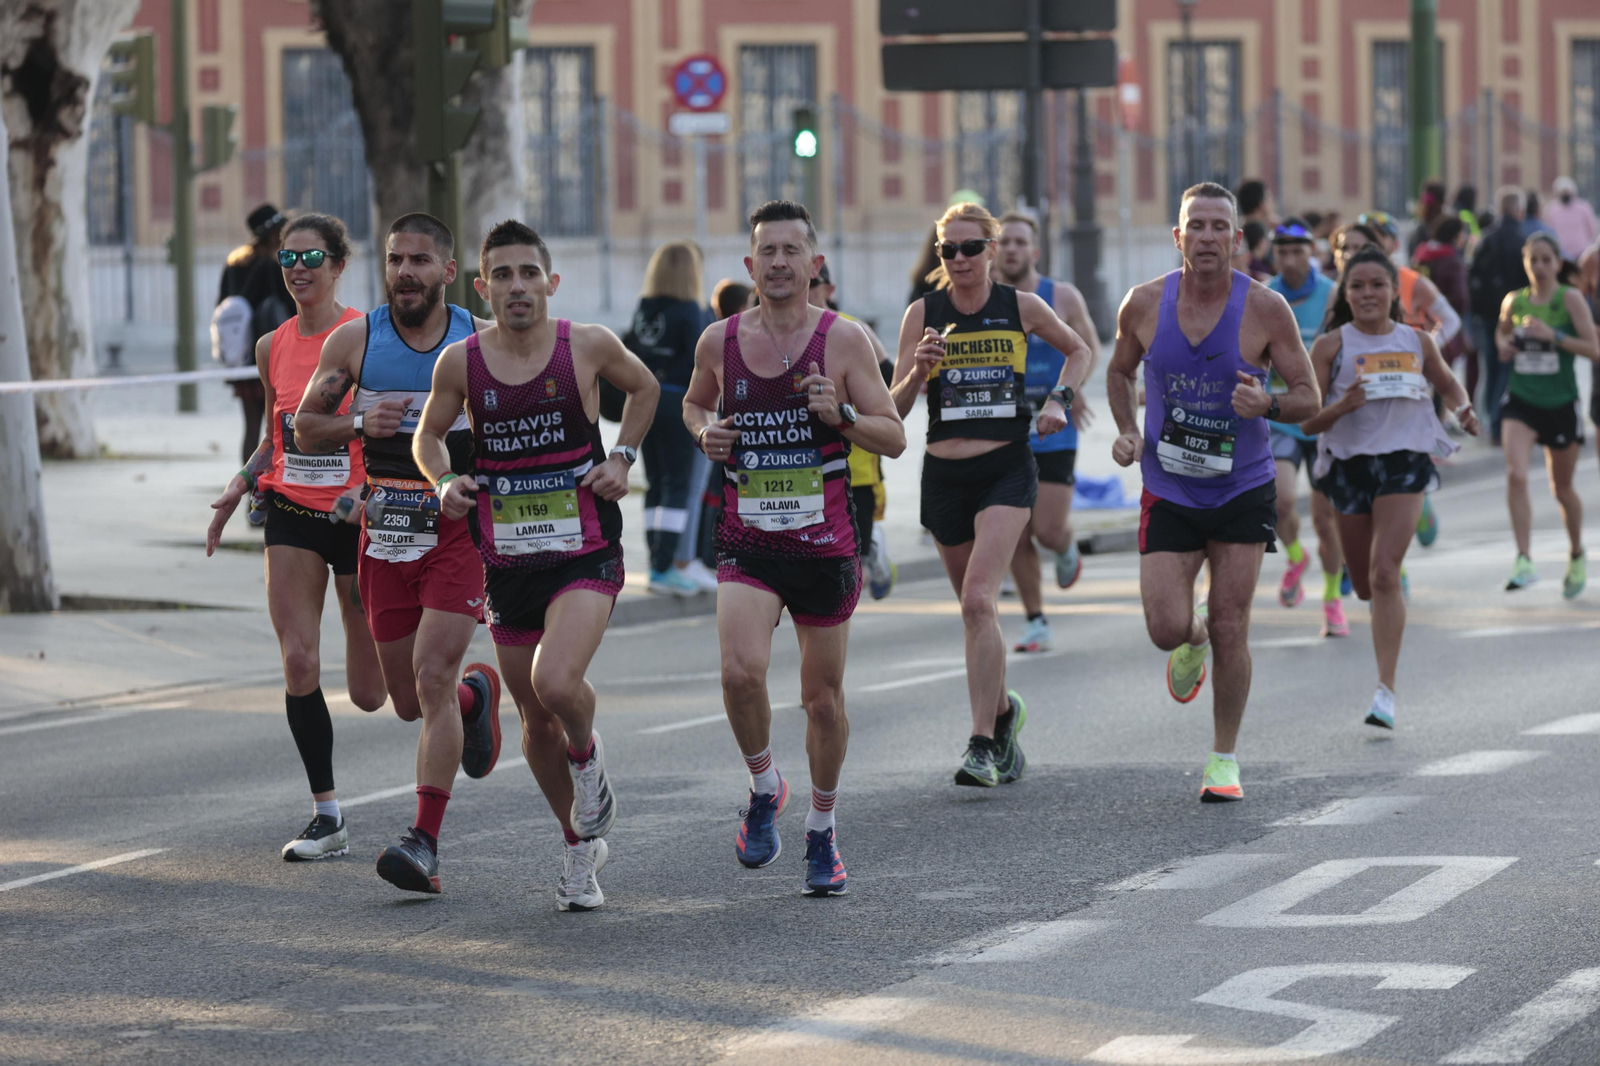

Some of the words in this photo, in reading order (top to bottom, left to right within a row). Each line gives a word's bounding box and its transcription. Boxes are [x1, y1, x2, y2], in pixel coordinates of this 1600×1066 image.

[950, 356, 991, 366] DISTRICT
[964, 370, 1006, 380] ZURICH
[966, 391, 991, 403] 3158
[733, 407, 809, 428] OCTAVUS
[965, 409, 994, 418] SARAH
[484, 411, 563, 434] OCTAVUS
[1187, 414, 1229, 430] ZURICH
[484, 427, 565, 452] TRIATLÓN
[737, 424, 812, 446] RIATLÓN
[1184, 434, 1210, 450] 1873
[288, 456, 343, 468] RUNNINGDIANA
[762, 452, 812, 466] ZURICH
[1182, 452, 1206, 464] SAGIV
[514, 476, 564, 491] ZURICH
[764, 480, 794, 493] 1212
[387, 491, 432, 504] ZURICH
[518, 504, 548, 517] 1159
[760, 500, 800, 511] CALAVIA
[383, 514, 410, 527] 2350
[516, 524, 556, 536] LAMATA
[378, 533, 415, 544] PABLOTE
